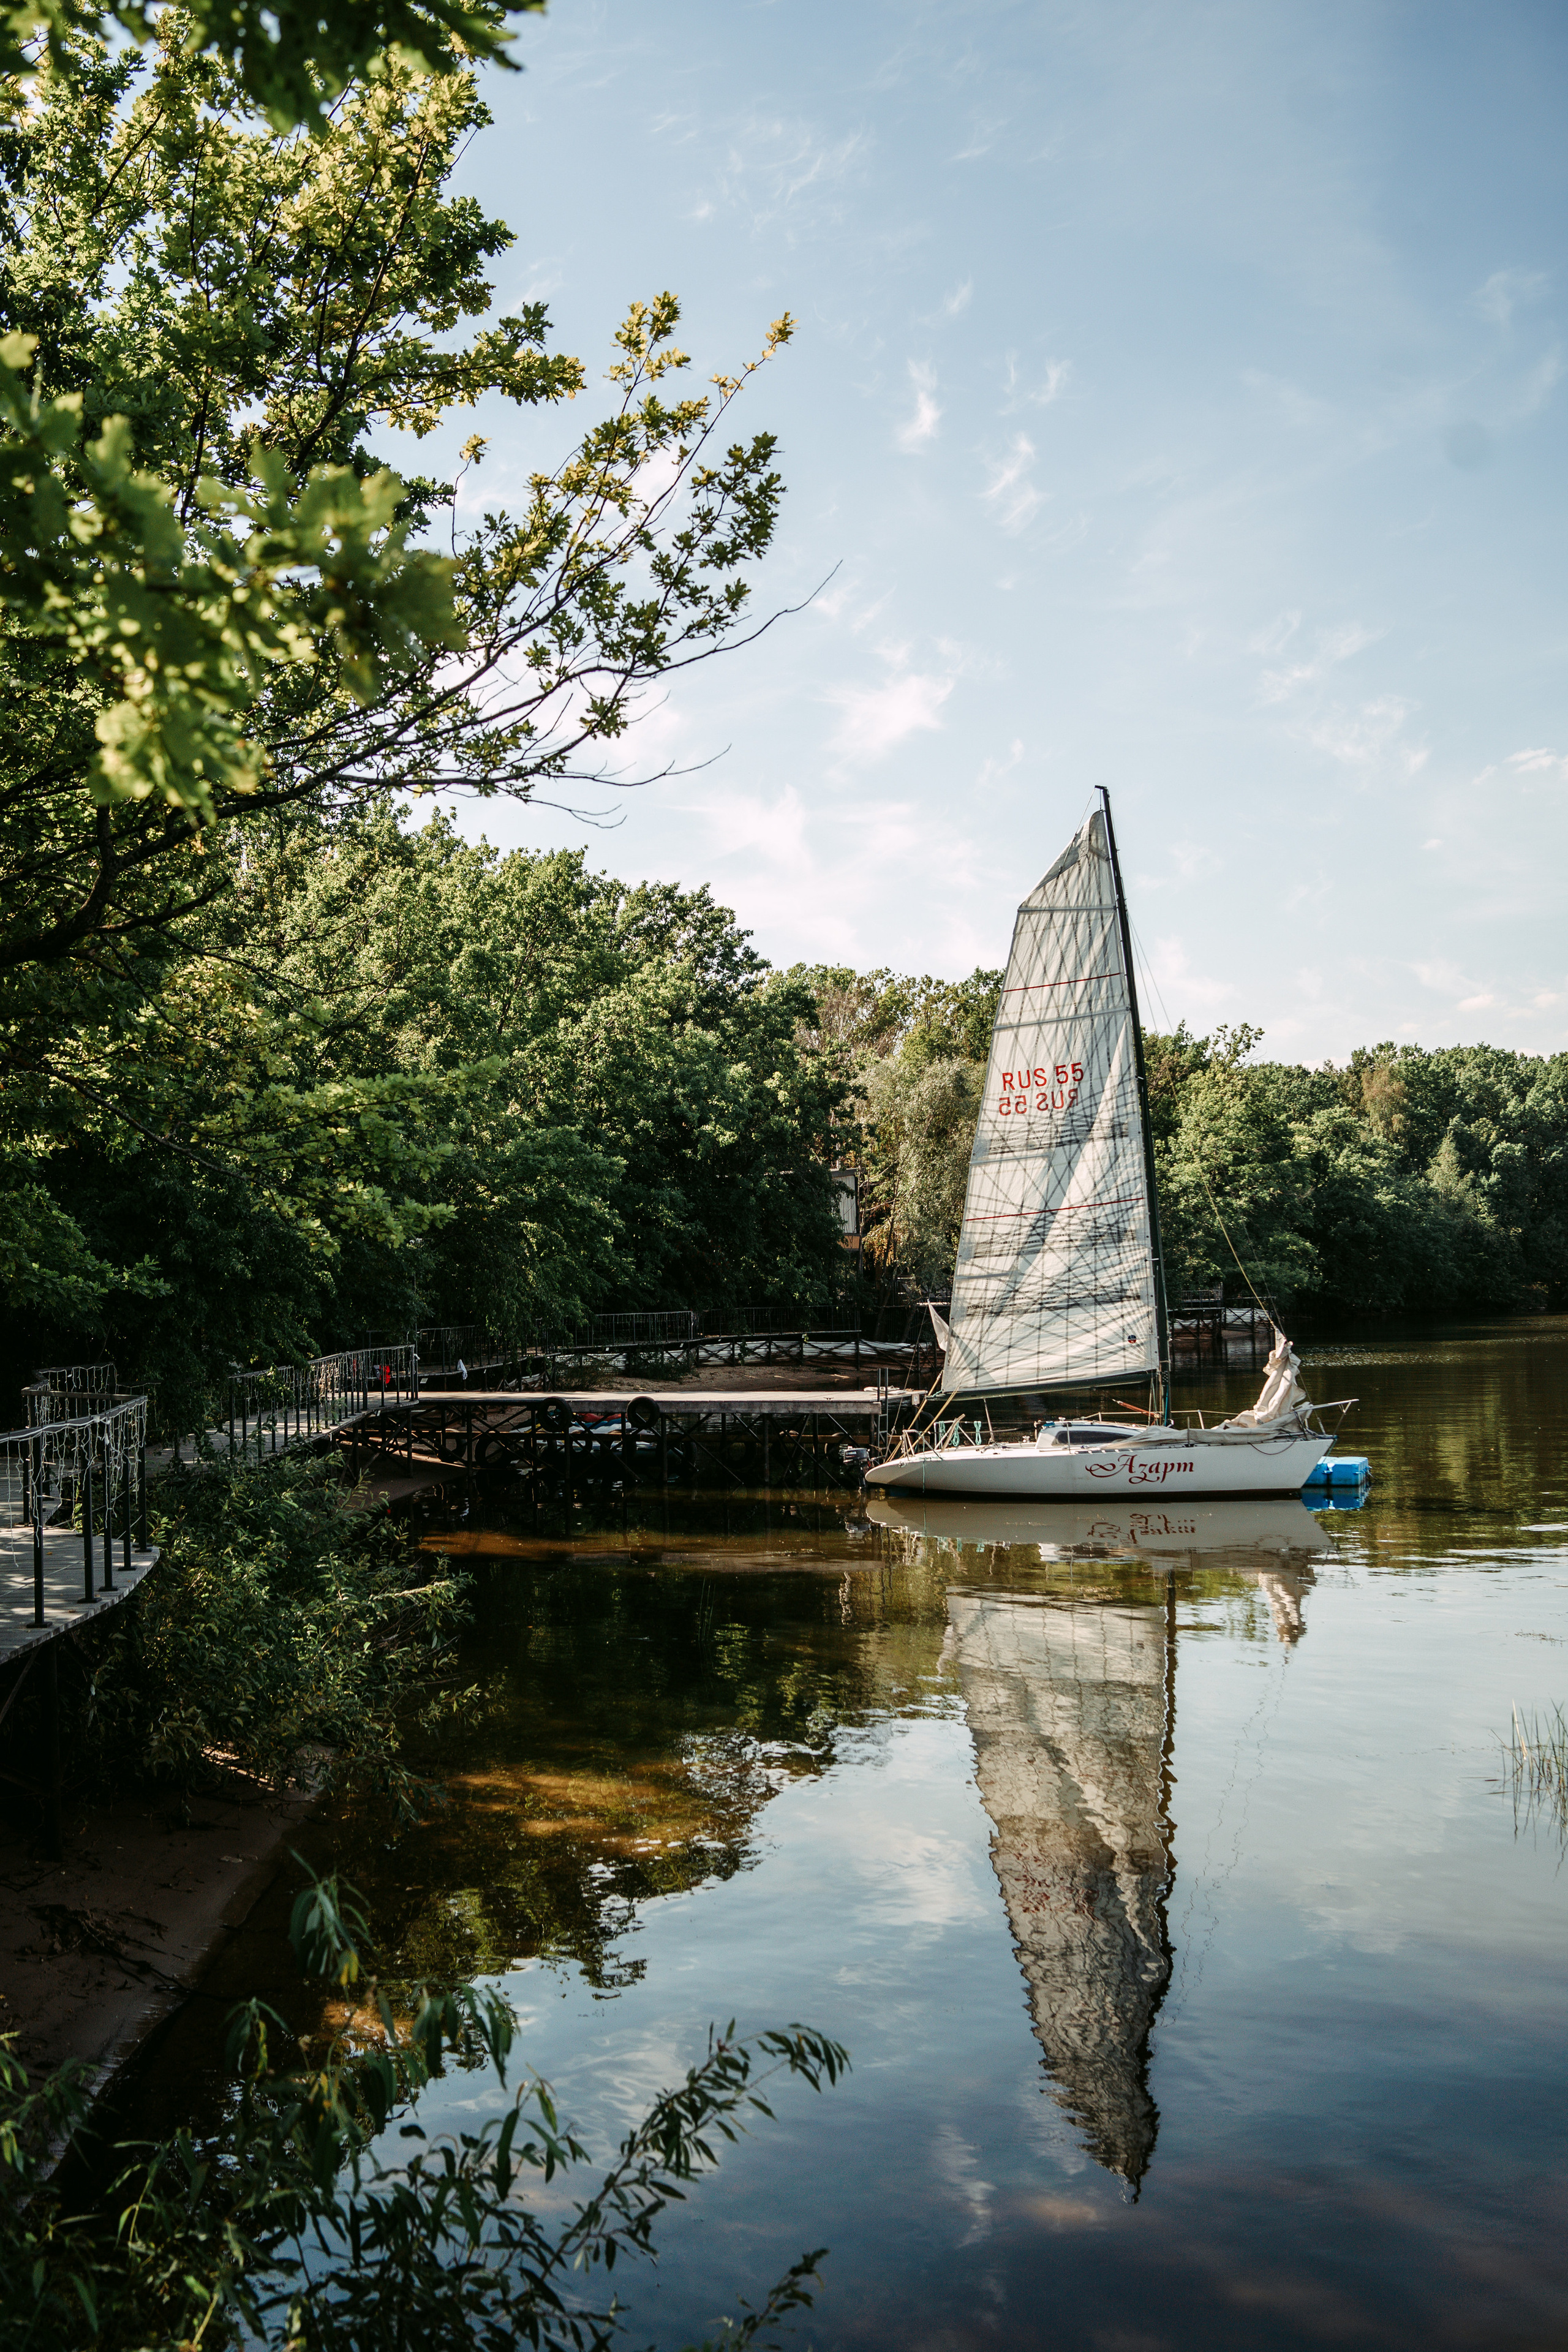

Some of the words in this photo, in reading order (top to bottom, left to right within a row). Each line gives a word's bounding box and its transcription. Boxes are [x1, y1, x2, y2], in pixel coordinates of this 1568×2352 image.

[1002, 1068, 1047, 1091] RUS
[1055, 1062, 1084, 1084] 55
[1085, 1454, 1194, 1484] Азарт
